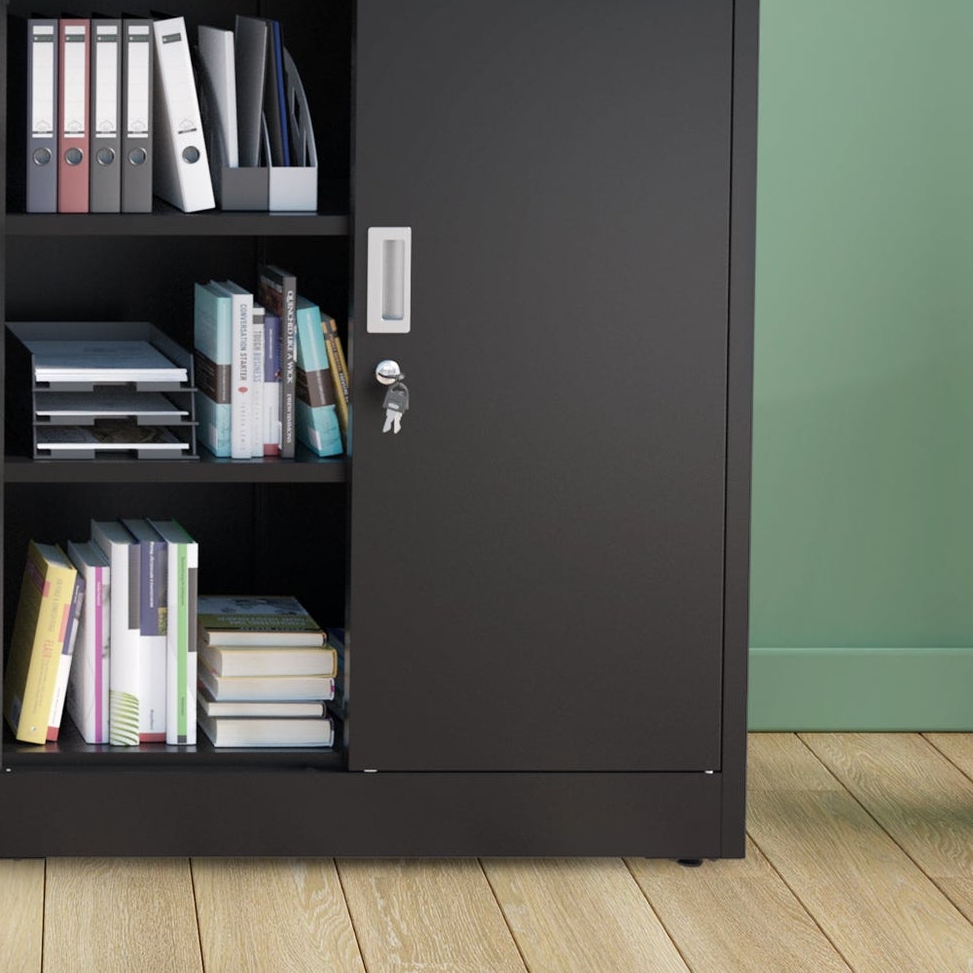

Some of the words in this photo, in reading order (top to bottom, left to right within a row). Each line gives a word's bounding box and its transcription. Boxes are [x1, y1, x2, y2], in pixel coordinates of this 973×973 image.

[286, 290, 294, 335] QUENCHED
[240, 304, 248, 351] CONVERSATION
[286, 335, 294, 352] LIKE
[240, 352, 248, 381] STARTER
[286, 360, 294, 384] WICK
